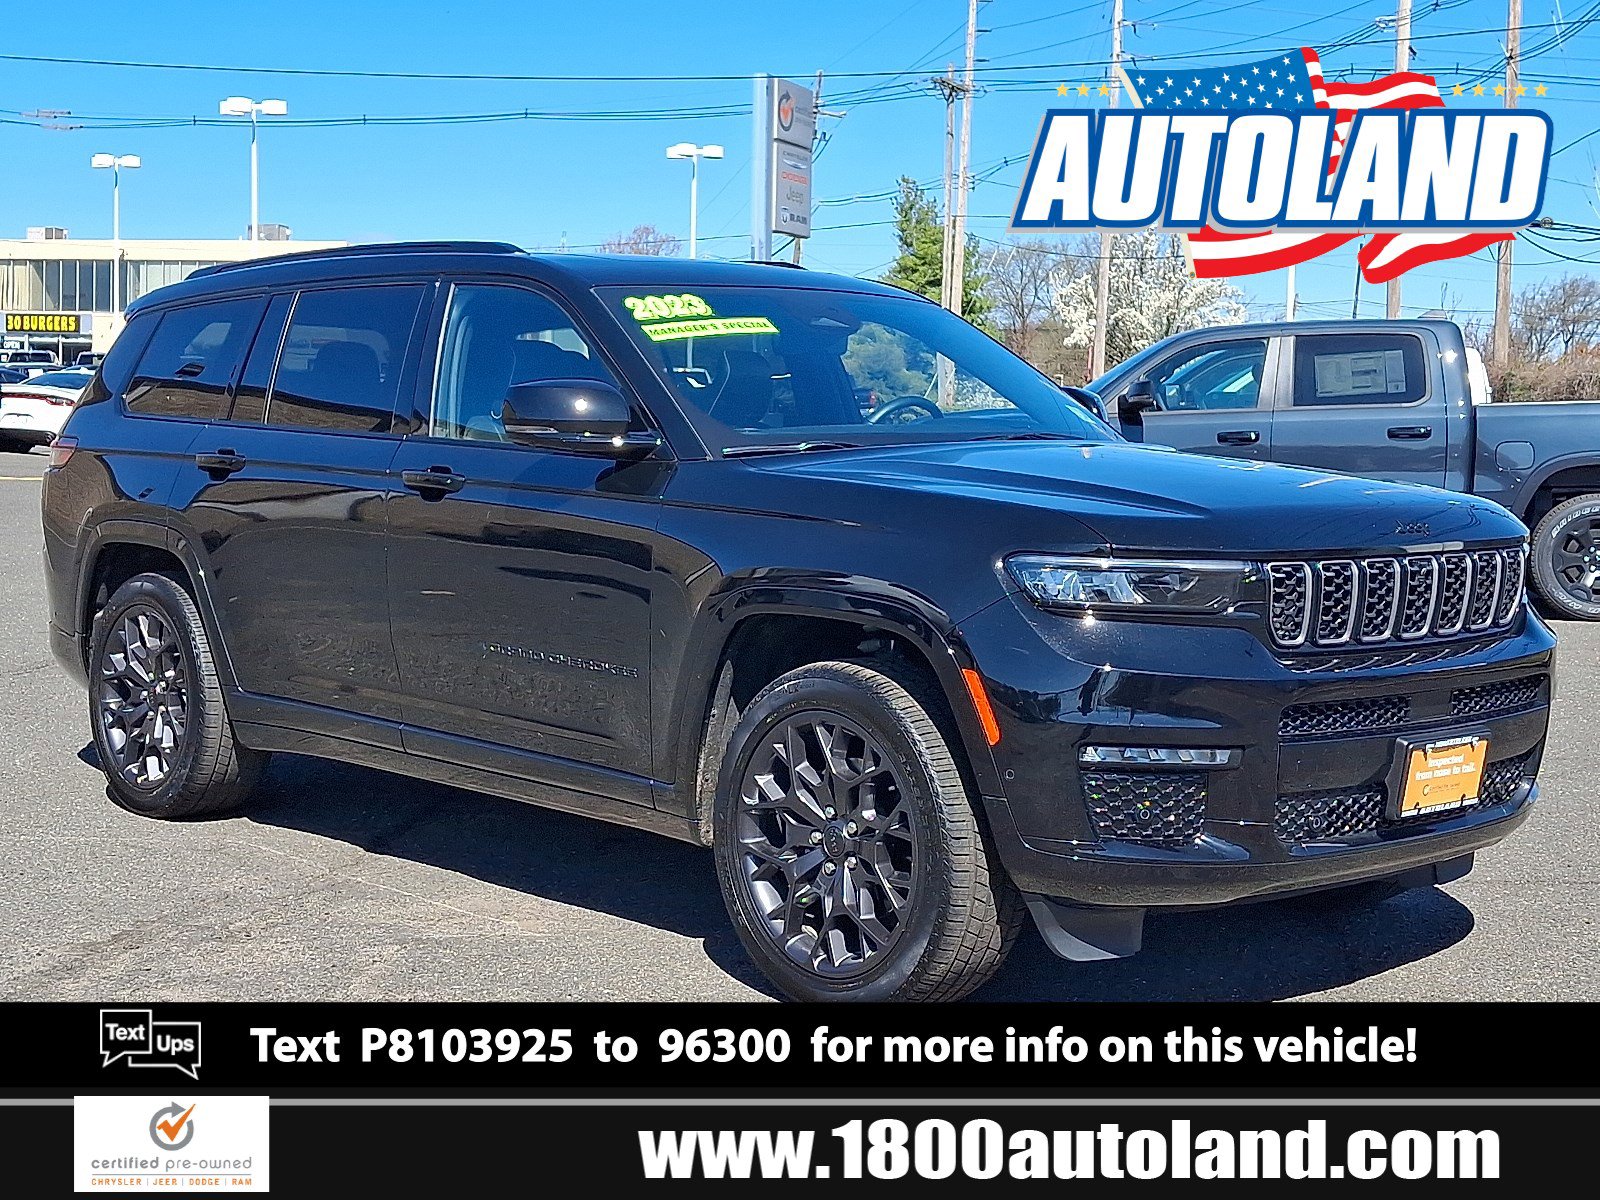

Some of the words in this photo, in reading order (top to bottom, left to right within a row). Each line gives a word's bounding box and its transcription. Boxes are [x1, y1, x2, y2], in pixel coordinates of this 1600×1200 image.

[786, 186, 804, 205] Jeep
[790, 213, 808, 225] RAM
[624, 293, 714, 321] 2023
[7, 315, 21, 331] 30
[23, 315, 76, 332] BURGERS
[649, 322, 719, 337] MANAGER'S
[721, 320, 771, 331] SPECIAL
